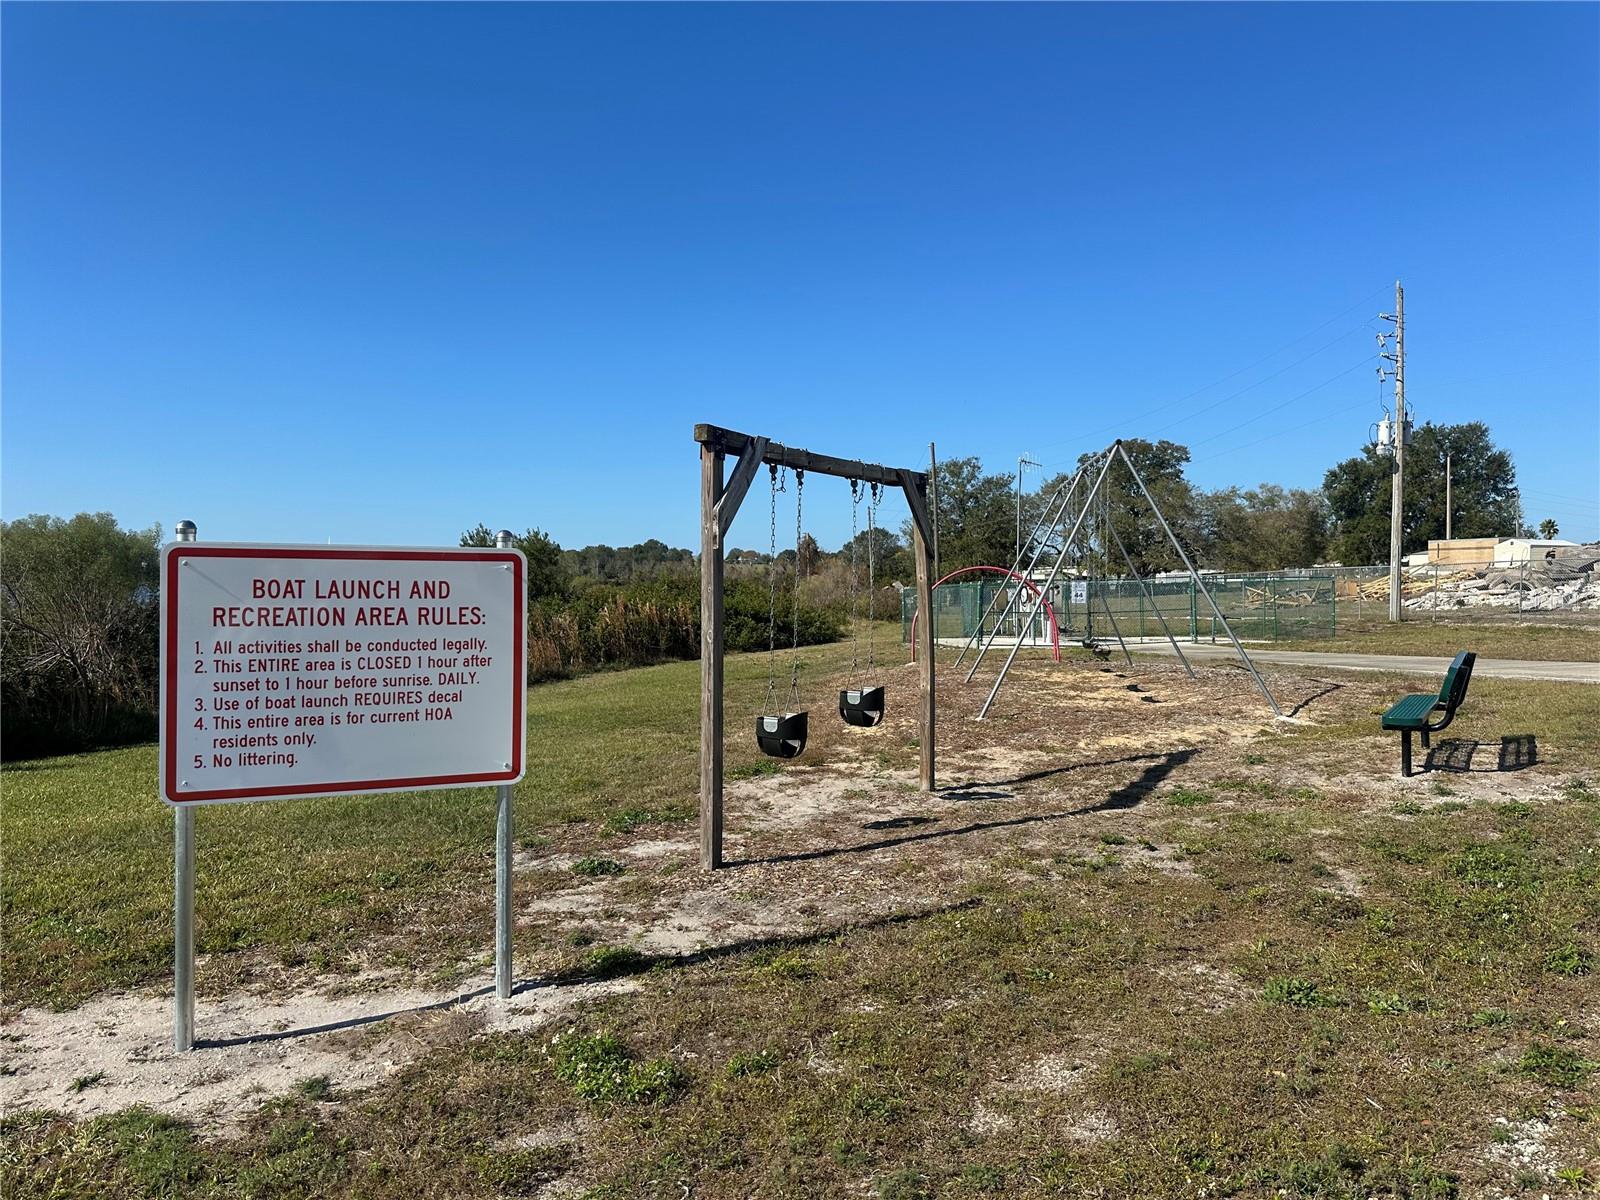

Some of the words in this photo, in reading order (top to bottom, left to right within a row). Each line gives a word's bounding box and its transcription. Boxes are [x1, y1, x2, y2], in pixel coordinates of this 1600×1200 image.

[252, 578, 306, 599] BOAT
[315, 579, 400, 599] LAUNCH
[409, 580, 451, 599] AND
[212, 606, 345, 627] RECREATION
[354, 606, 409, 626] AREA
[417, 606, 486, 626] RULES:
[194, 641, 204, 655] 1.
[213, 640, 233, 655] All
[237, 639, 303, 654] activities
[306, 639, 339, 653] shall
[345, 639, 362, 653] be
[366, 637, 438, 653] conducted
[442, 636, 488, 653] legally.
[194, 659, 207, 674] 2.
[213, 659, 243, 674] This
[247, 658, 300, 673] ENTIRE
[305, 659, 335, 672] area
[341, 657, 352, 671] is
[357, 655, 411, 671] CLOSED
[417, 655, 422, 669] 1
[427, 655, 458, 669] hour
[462, 653, 492, 668] after
[212, 679, 261, 693] sunset
[265, 678, 279, 691] to
[285, 677, 290, 691] 1
[296, 676, 328, 691] hour
[334, 675, 378, 689] before
[382, 673, 434, 688] sunrise.
[437, 671, 480, 686] DAILY.
[194, 697, 207, 712] 3.
[213, 697, 241, 712] Use
[244, 696, 259, 710] of
[265, 695, 297, 709] boat
[301, 694, 349, 709] launch
[354, 691, 423, 706] REQUIRES
[427, 690, 462, 704] decal
[193, 716, 208, 731] 4.
[213, 716, 242, 730] This
[247, 714, 289, 729] entire
[294, 713, 325, 727] area
[330, 711, 341, 726] is
[345, 710, 365, 725] for
[369, 709, 420, 724] current
[424, 708, 453, 721] HOA
[212, 732, 279, 749] residents
[283, 732, 317, 748] only.
[193, 754, 207, 769] 5.
[213, 753, 233, 767] No
[238, 751, 299, 767] littering.
